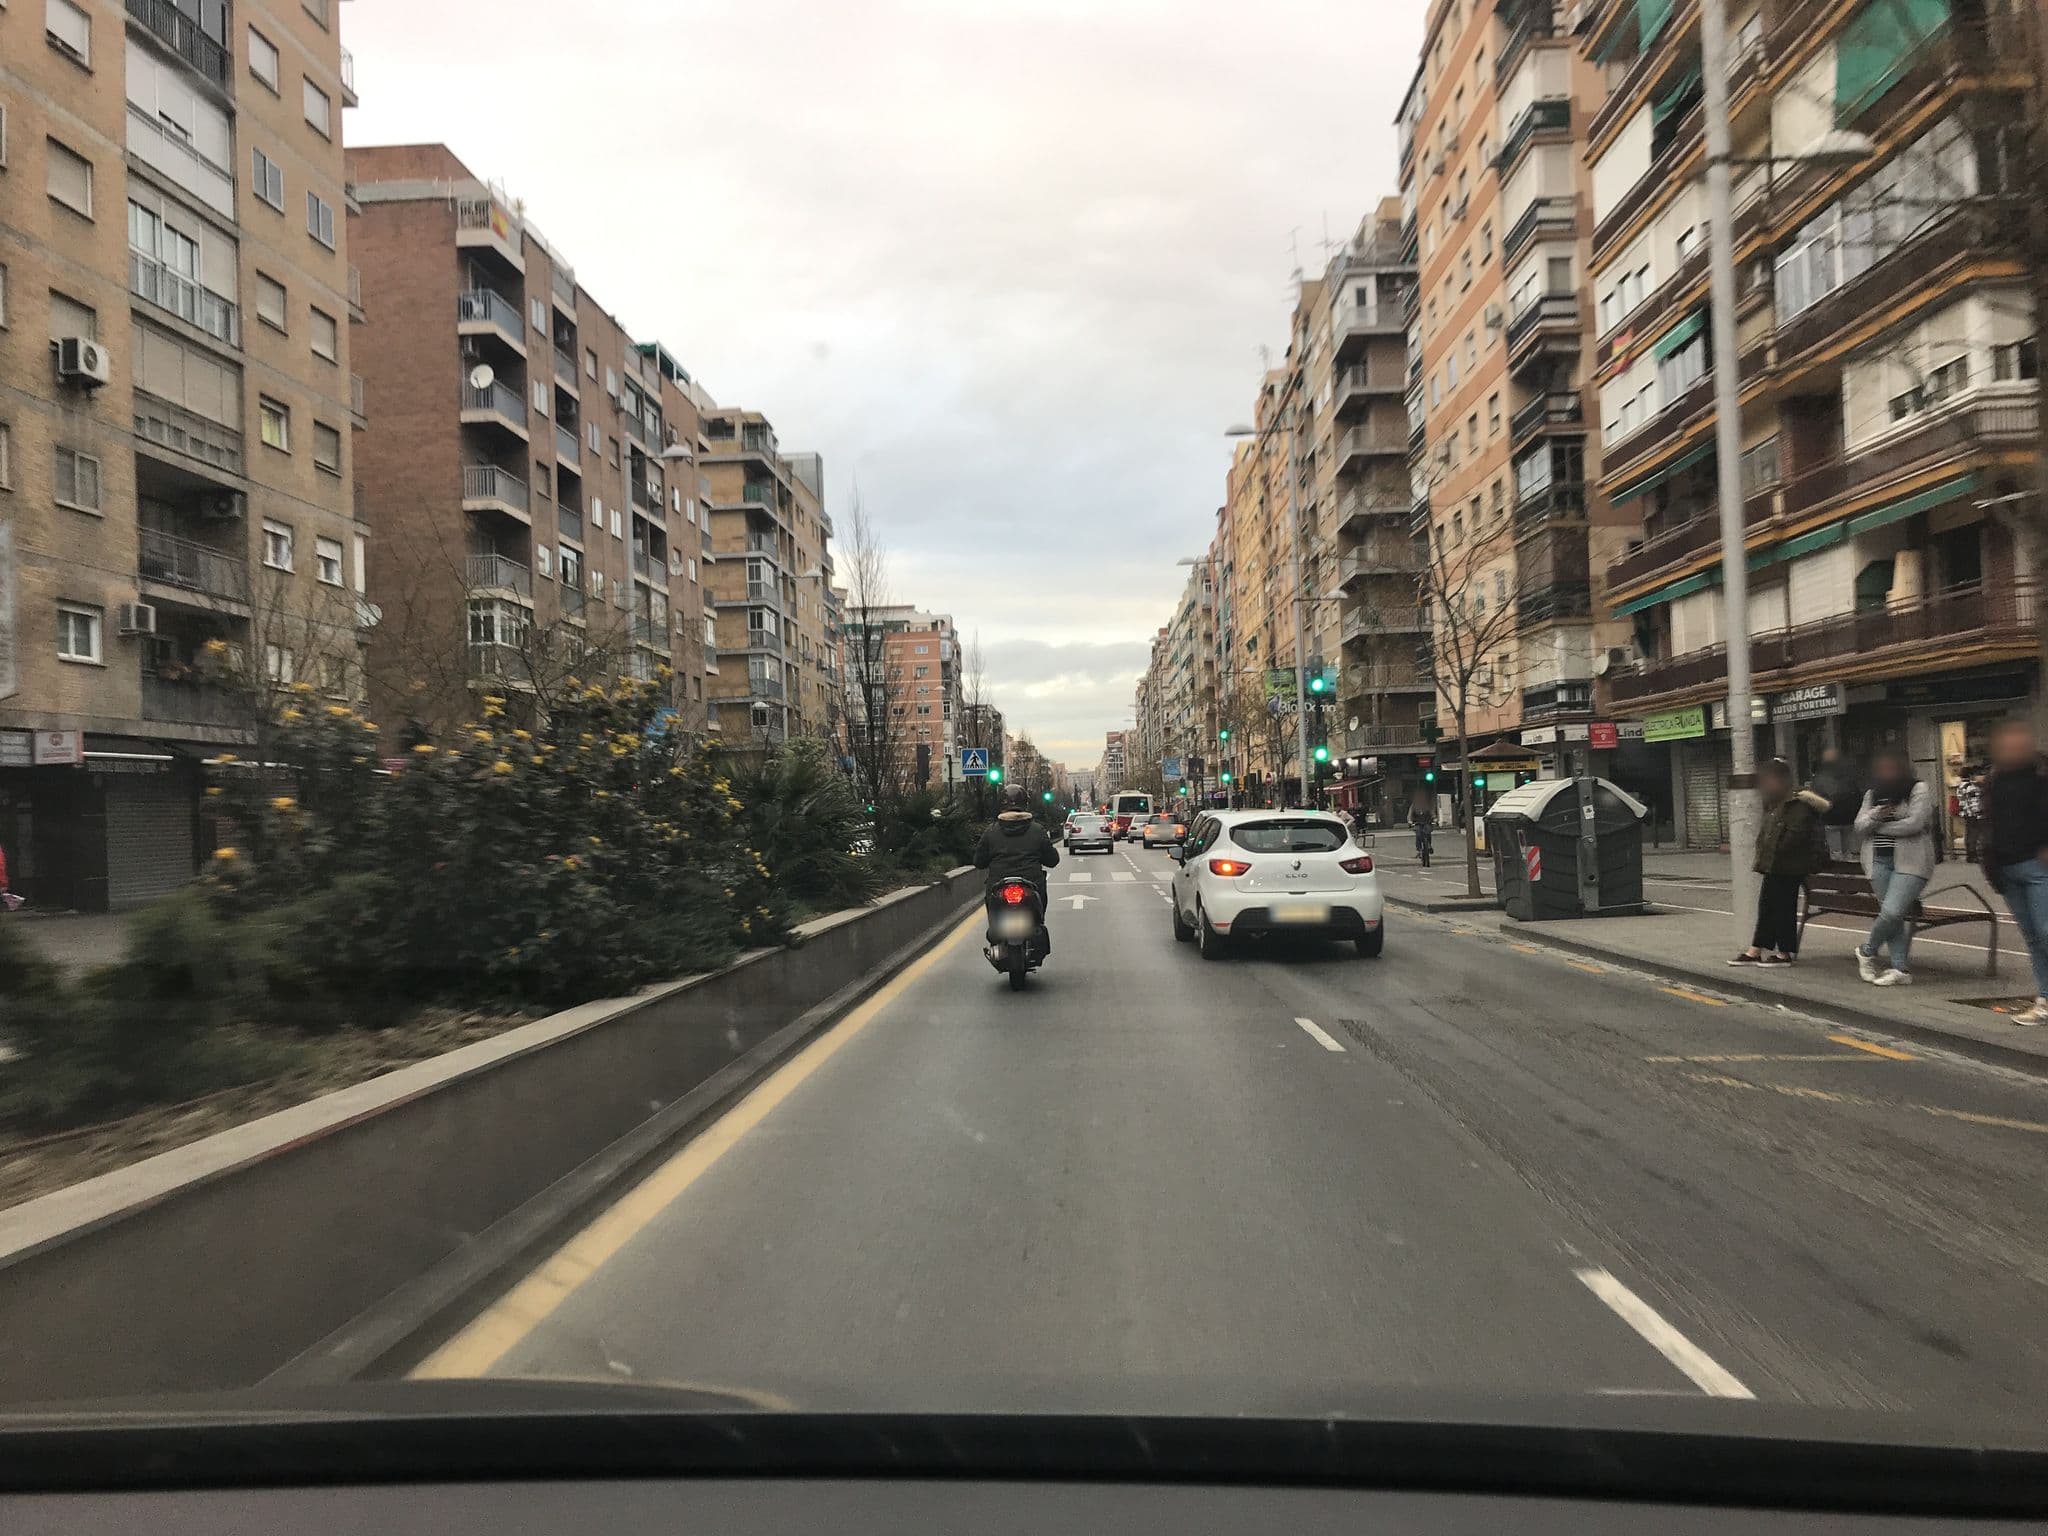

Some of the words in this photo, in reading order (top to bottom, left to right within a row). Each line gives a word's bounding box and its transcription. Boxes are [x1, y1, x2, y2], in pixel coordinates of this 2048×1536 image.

[1781, 686, 1826, 703] GARAGE
[1772, 704, 1797, 714] AUTOS
[1798, 697, 1837, 710] FORTUNA
